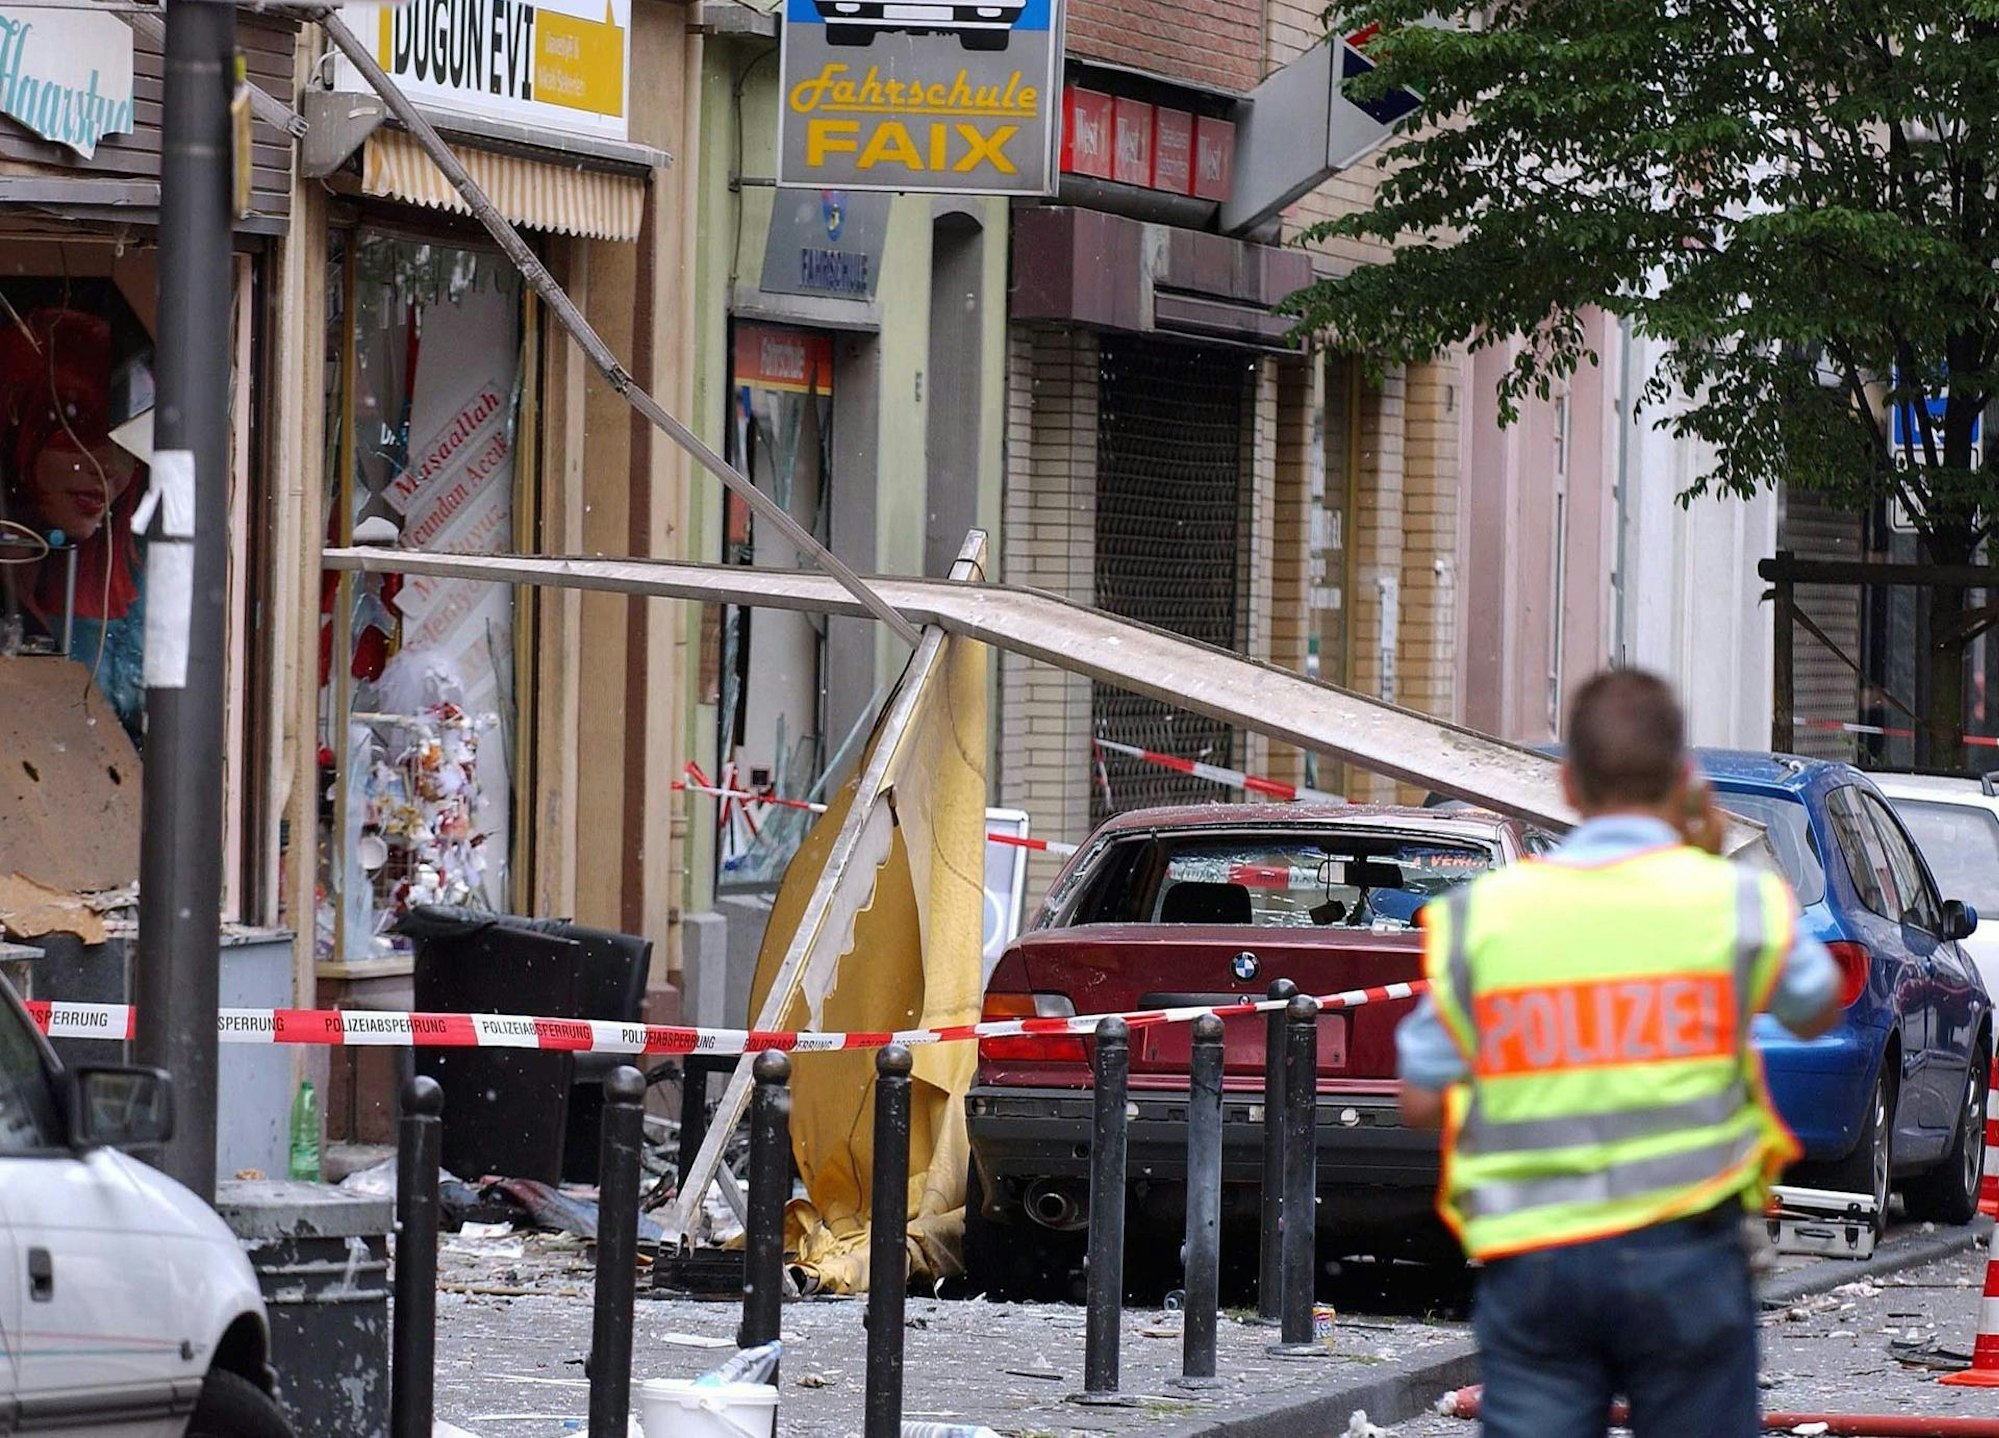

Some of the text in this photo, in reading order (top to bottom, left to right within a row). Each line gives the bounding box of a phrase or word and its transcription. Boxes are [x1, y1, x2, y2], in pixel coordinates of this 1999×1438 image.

[789, 62, 1038, 114] Fahrschule
[806, 117, 1020, 174] FAIX
[217, 1015, 284, 1032] SPERRUNG
[325, 1018, 447, 1034] POLIZEIABSPERRUNG
[482, 1021, 591, 1040] POLIZEIABSPERRUNG
[622, 1028, 716, 1049] POLIZEIABSPERRUNG
[1484, 976, 1717, 1071] POLIZEI
